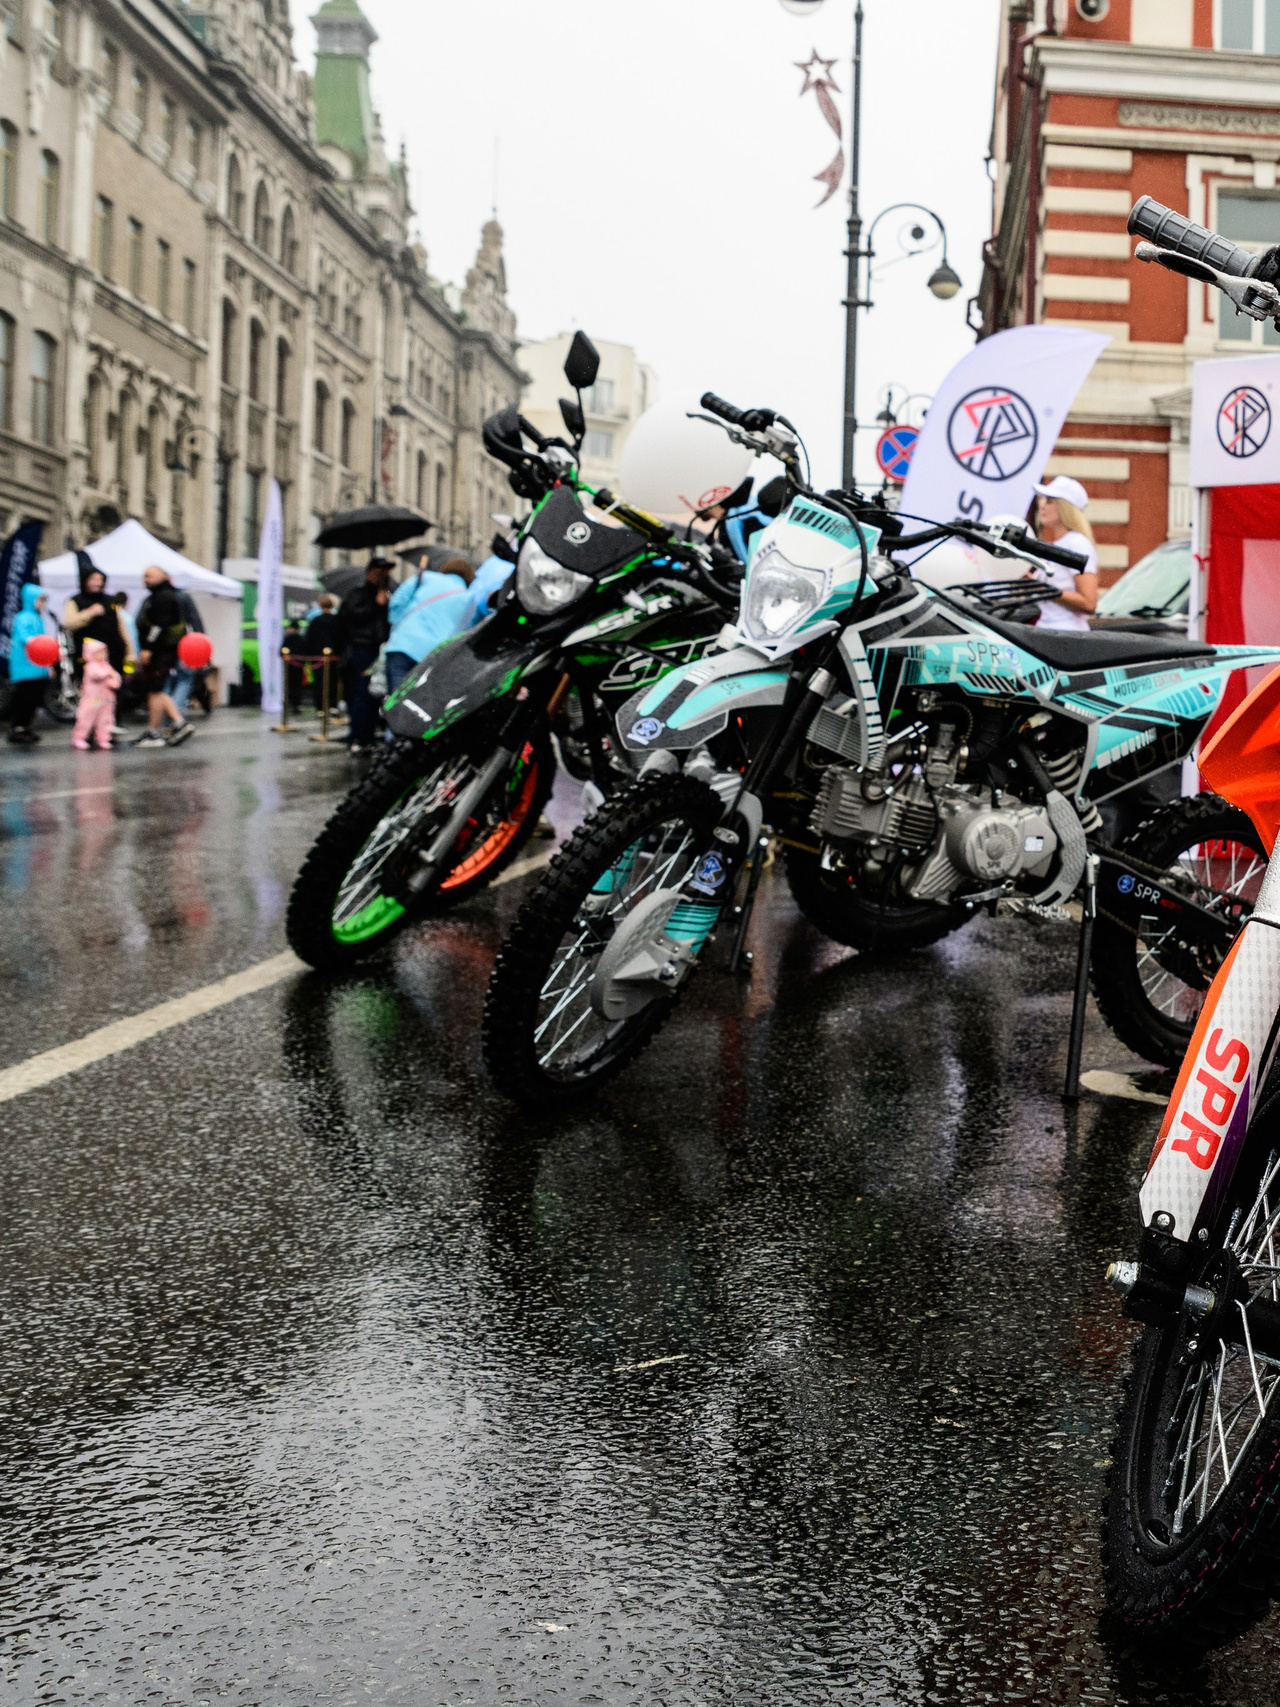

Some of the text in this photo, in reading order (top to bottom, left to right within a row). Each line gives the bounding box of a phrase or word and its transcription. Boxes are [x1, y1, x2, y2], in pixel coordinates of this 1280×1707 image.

[967, 640, 1001, 665] SPR
[1134, 883, 1161, 905] SPR
[1171, 1028, 1250, 1170] SPR
